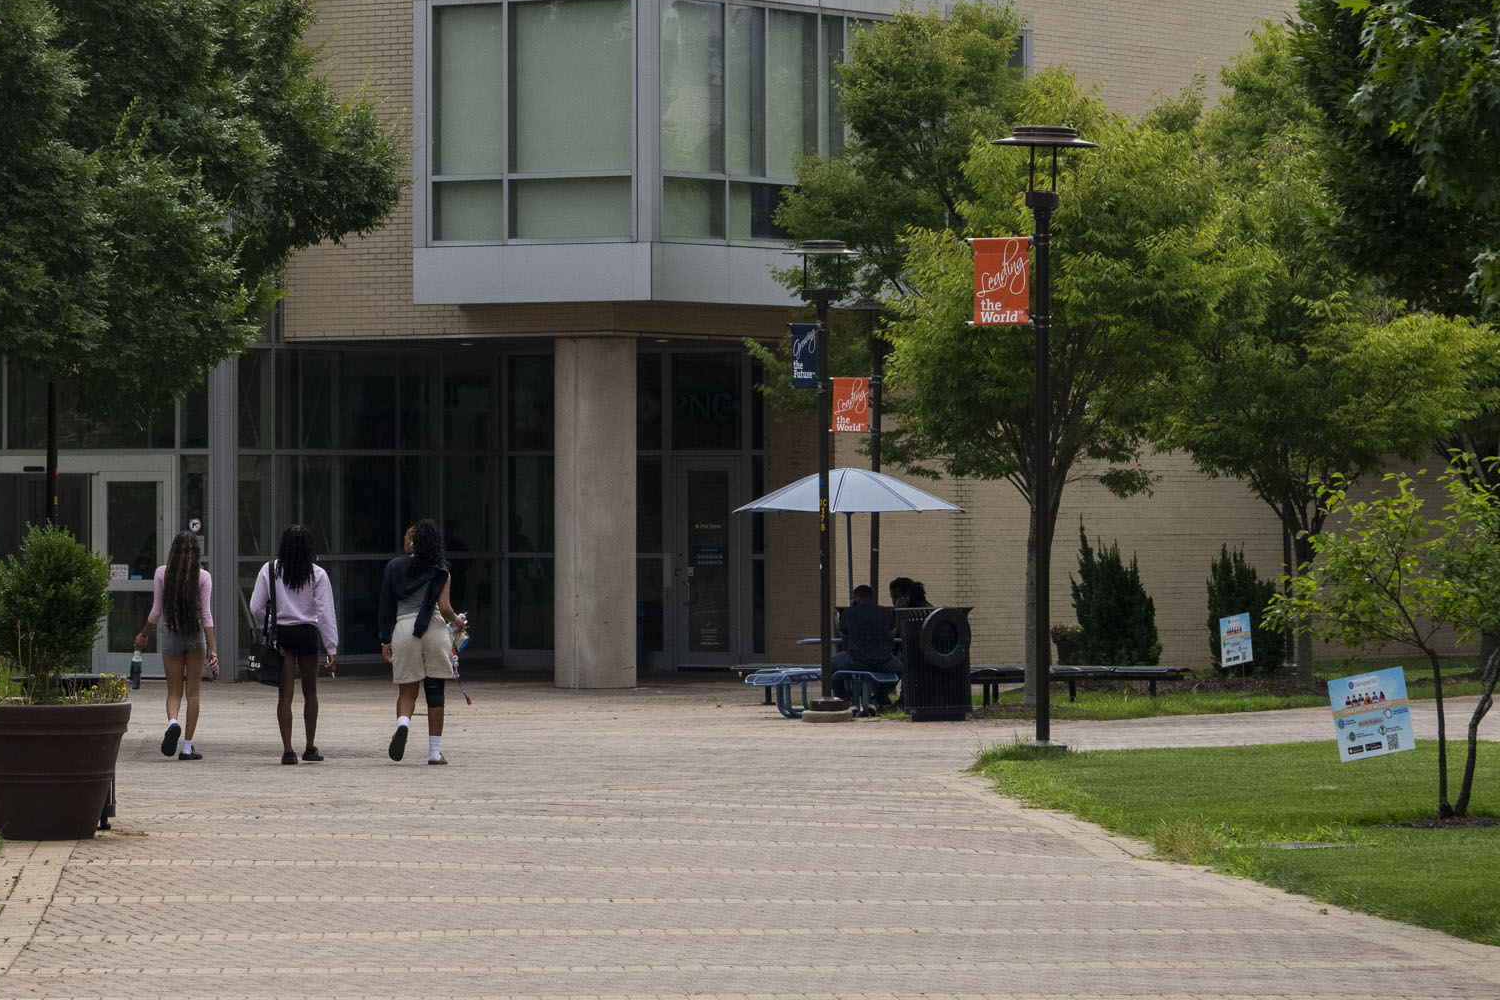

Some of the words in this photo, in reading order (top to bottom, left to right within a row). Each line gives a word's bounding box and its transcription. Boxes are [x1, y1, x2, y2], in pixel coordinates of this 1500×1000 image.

[976, 238, 1030, 297] Leading
[980, 299, 1002, 311] the
[793, 360, 804, 370] the
[836, 415, 851, 424] the
